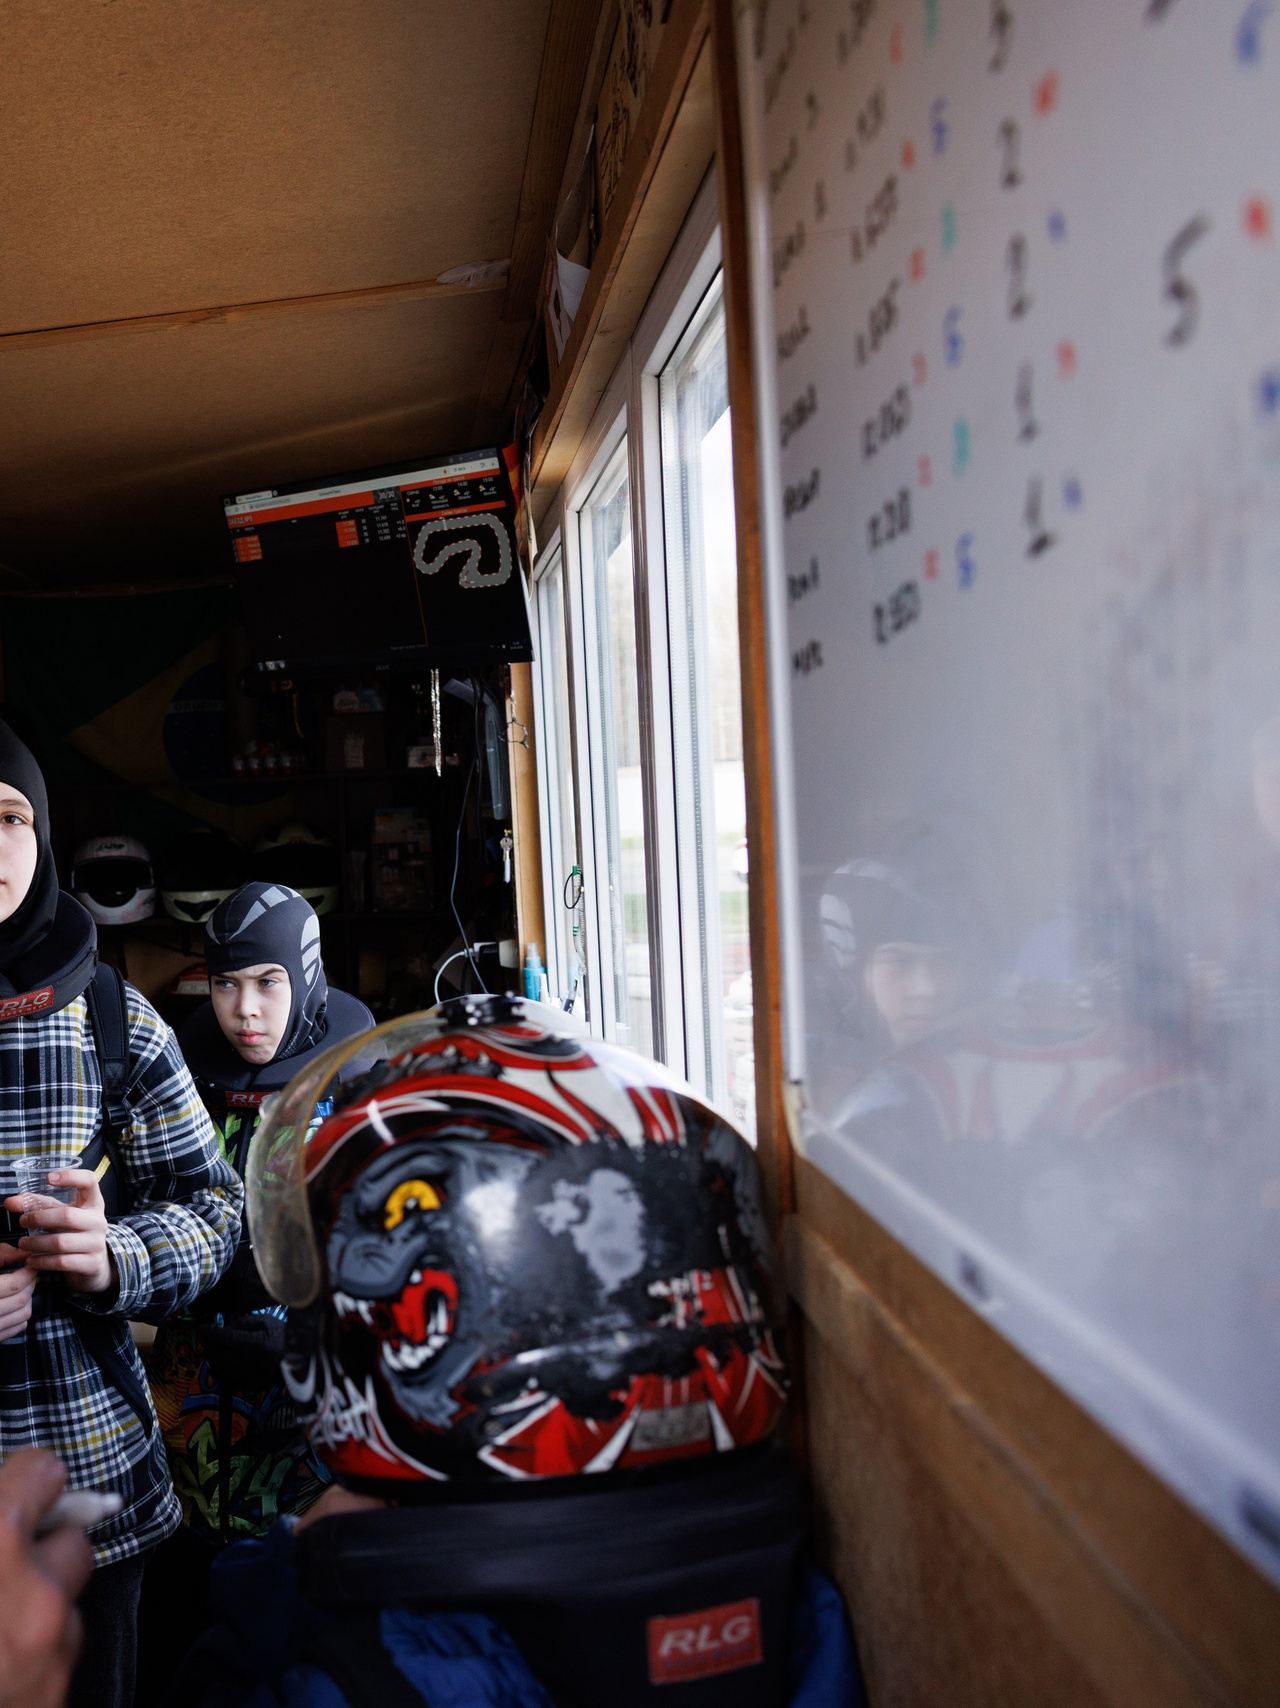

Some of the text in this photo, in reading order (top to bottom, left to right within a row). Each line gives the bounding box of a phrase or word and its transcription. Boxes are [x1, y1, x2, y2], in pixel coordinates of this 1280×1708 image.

[378, 490, 395, 500] 30/30
[0, 992, 50, 1012] RLG
[657, 1614, 752, 1656] RLG
